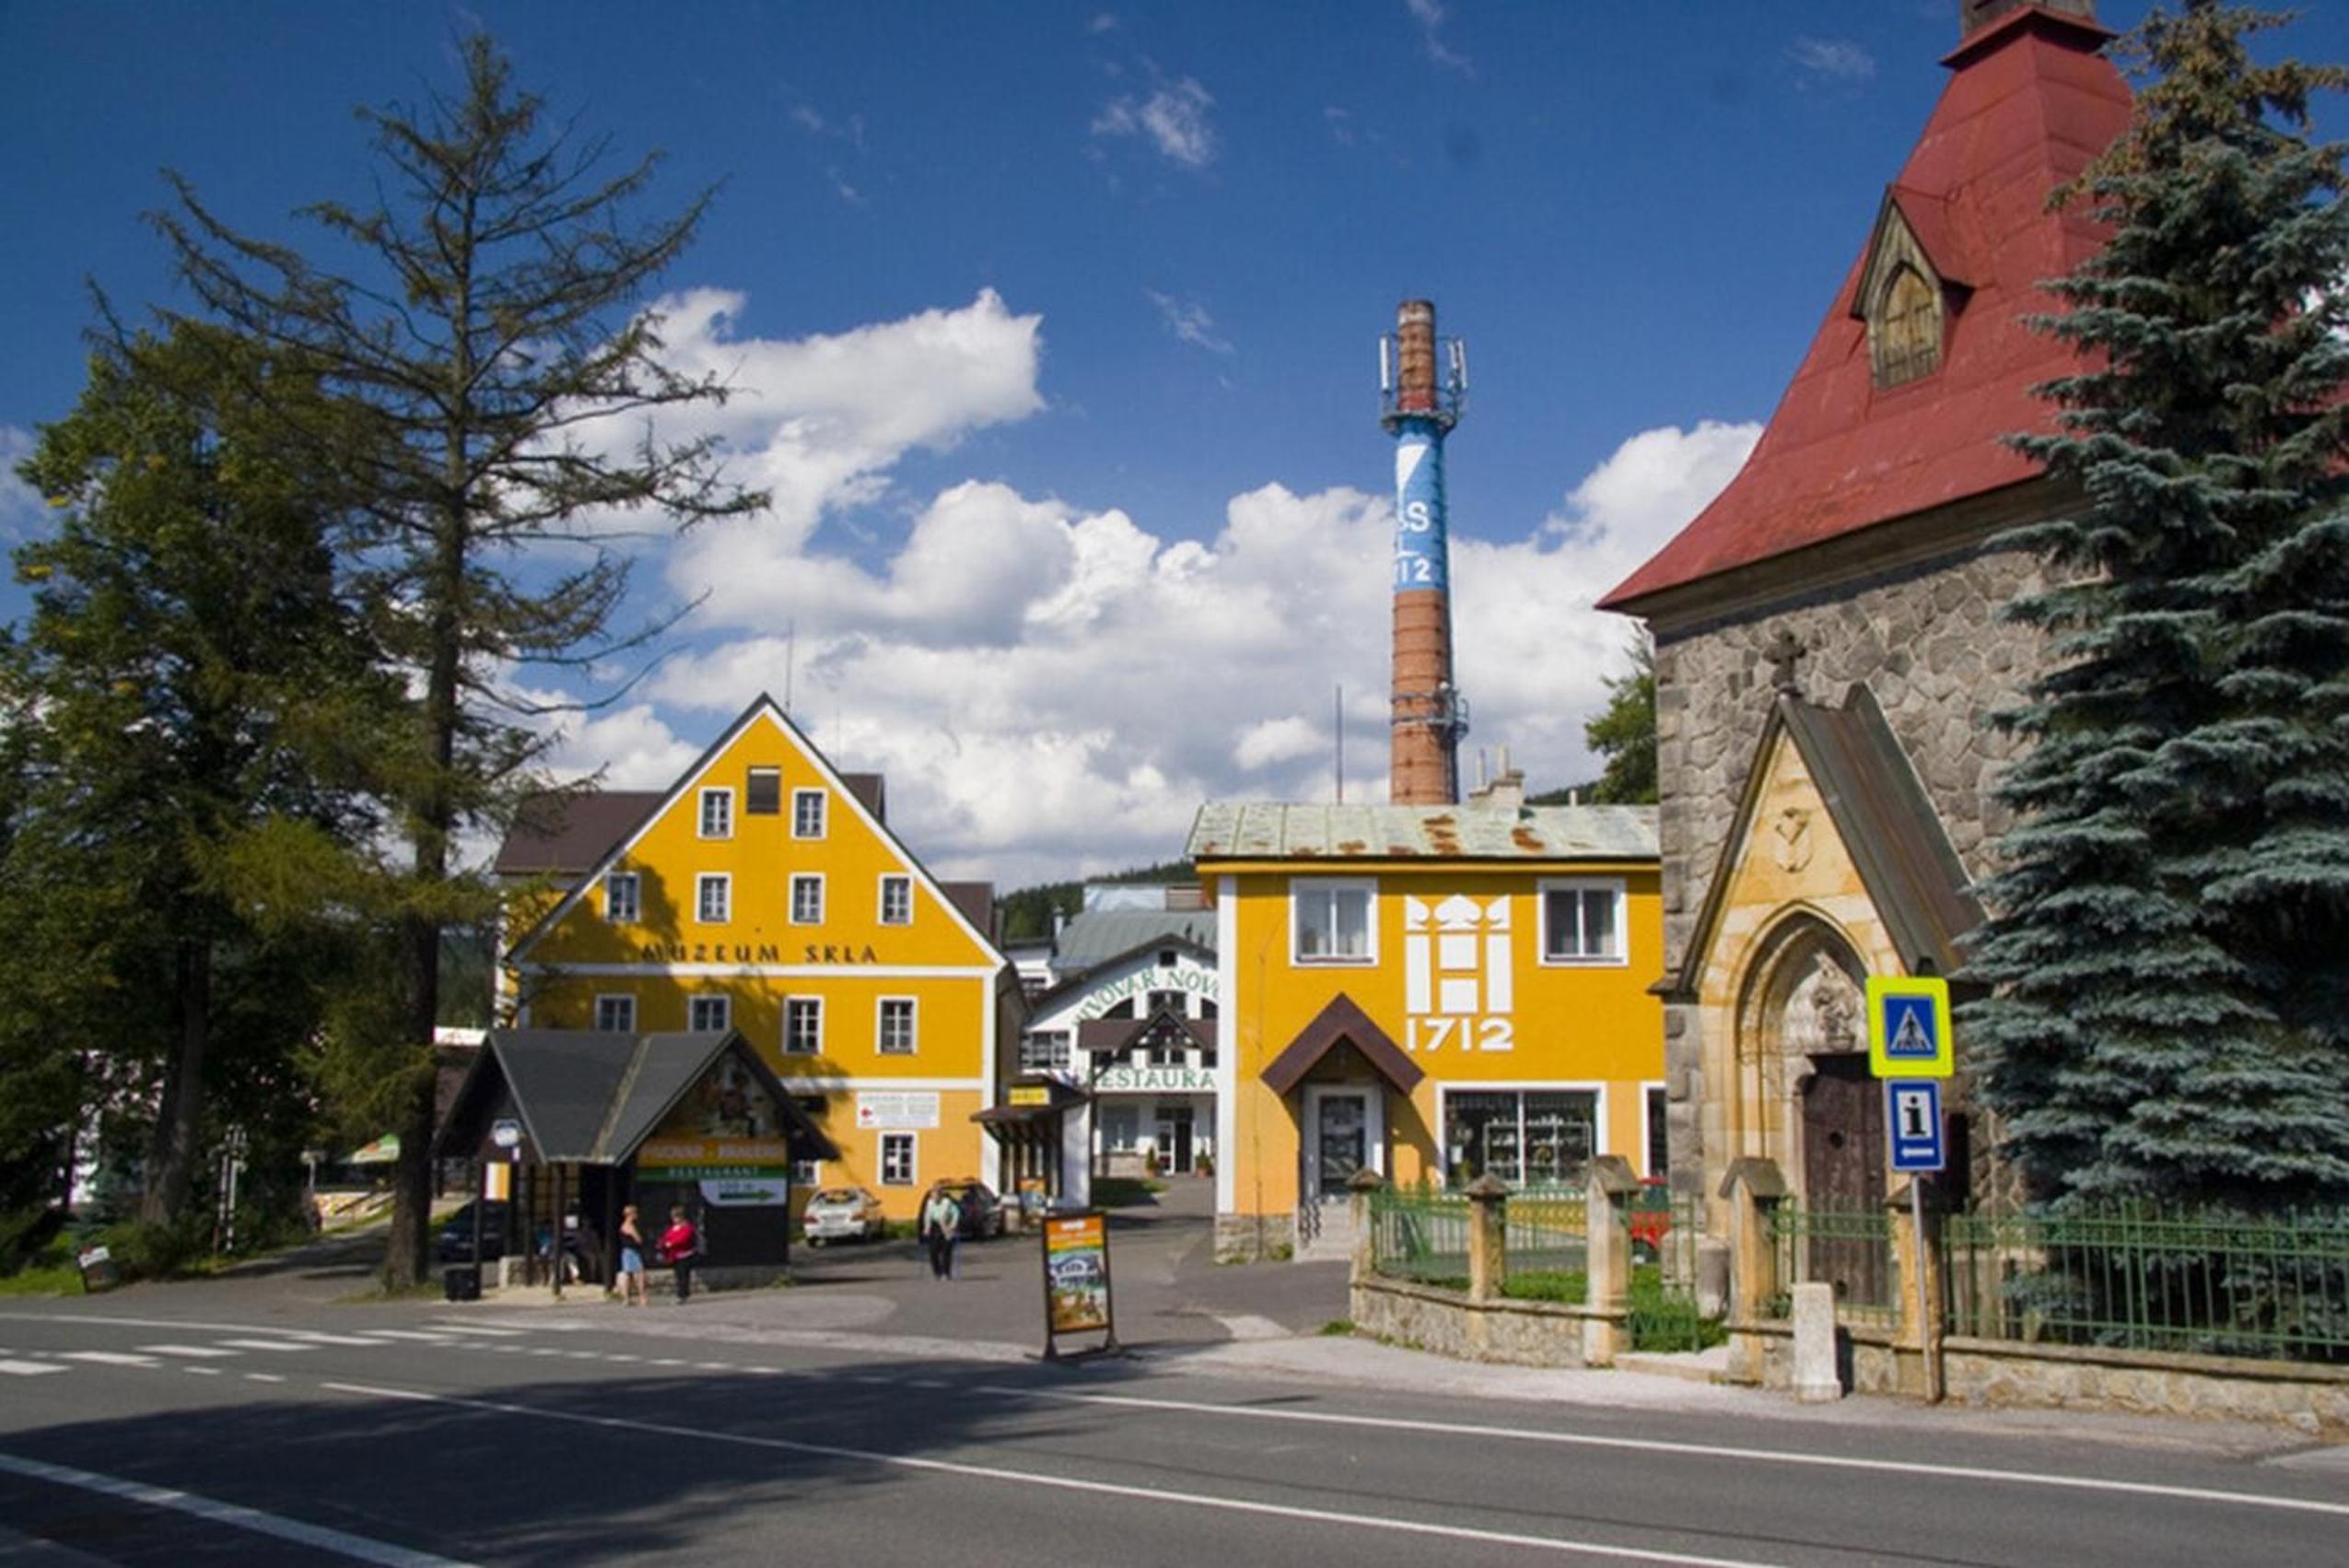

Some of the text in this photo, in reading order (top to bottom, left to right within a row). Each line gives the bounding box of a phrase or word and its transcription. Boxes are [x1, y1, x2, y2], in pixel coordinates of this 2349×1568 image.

[642, 943, 878, 963] MUZEUM SKLA
[1167, 969, 1218, 998] NOV
[1407, 1017, 1514, 1050] 1712
